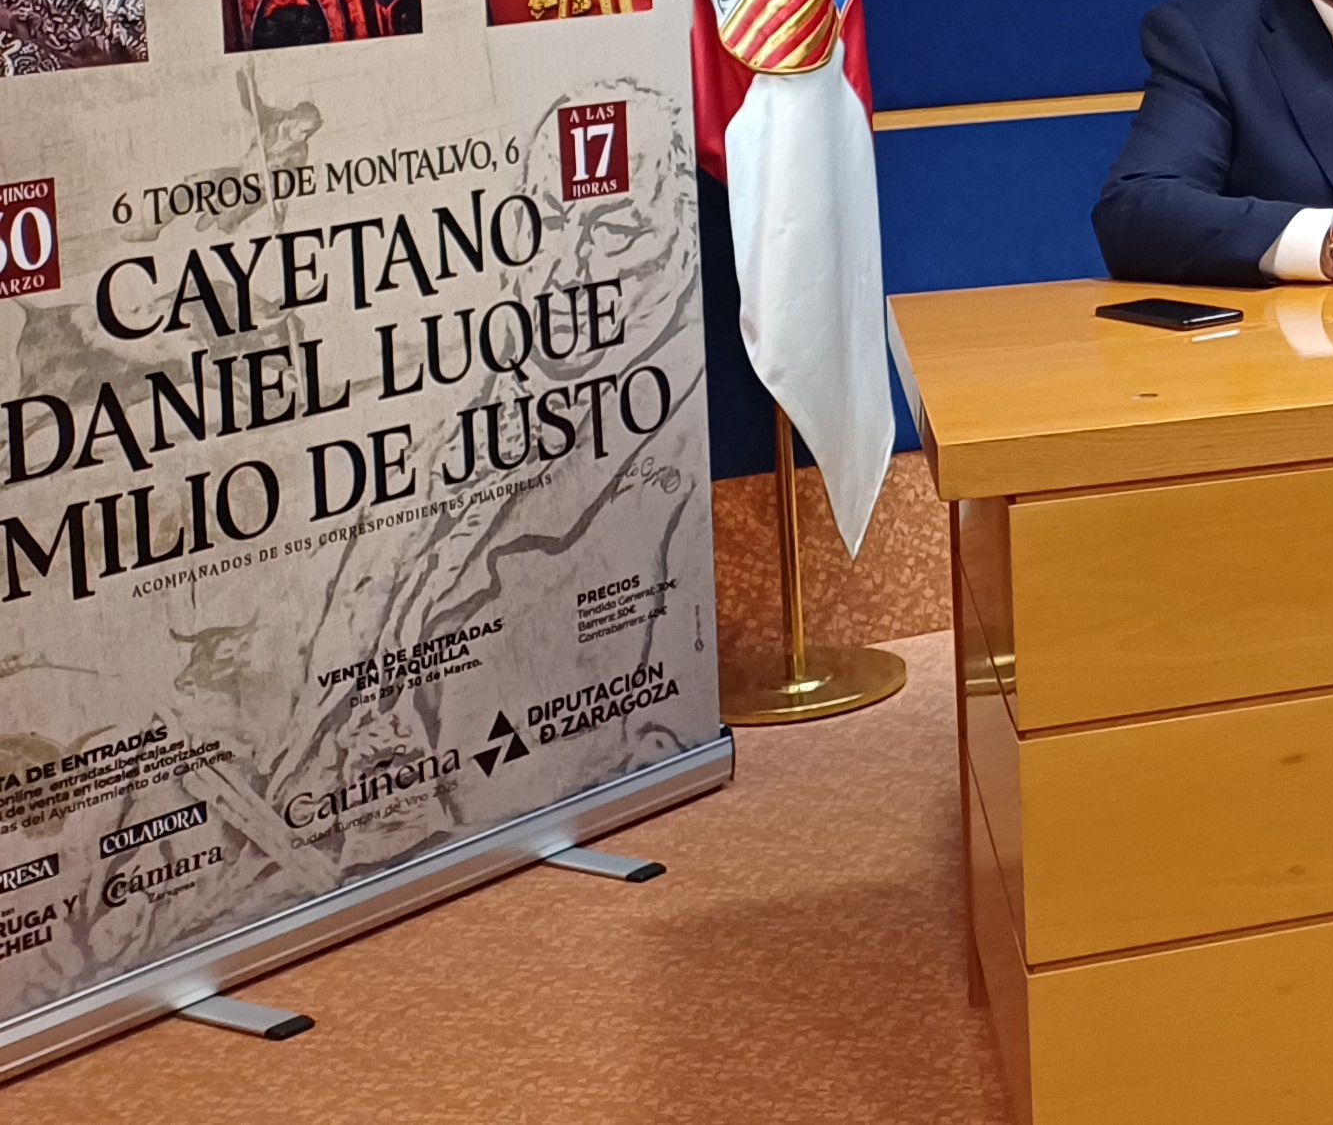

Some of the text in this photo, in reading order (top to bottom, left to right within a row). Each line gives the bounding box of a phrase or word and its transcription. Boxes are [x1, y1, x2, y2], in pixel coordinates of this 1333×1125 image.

[569, 104, 616, 124] A LAS
[111, 135, 521, 226] 6 TOROS DE MONTALVO, 6
[570, 122, 615, 182] 17
[0, 182, 49, 207] MINGO
[572, 178, 618, 198] HORAS
[0, 206, 52, 271] 0
[95, 189, 544, 342] CAYETANO
[1, 278, 627, 485] DANIEL LUQUE
[305, 424, 418, 523] DE
[440, 365, 672, 486] JUSTO
[131, 473, 553, 599] ACOMPAÑADOS DE SUS CORRESPONDIENTES CUADRILLAS
[576, 574, 641, 608] PRECIOS
[577, 599, 617, 620] Tendido
[317, 618, 505, 688] VENTA DE ENTRADAS
[356, 644, 470, 691] EN TAQUILLA
[407, 676, 423, 690] 30
[425, 670, 441, 683] de
[527, 661, 664, 728] DIPUTACIÓN
[560, 679, 680, 738] ZARAGOZA
[5, 804, 26, 819] de
[28, 790, 70, 812] venta
[73, 783, 91, 798] en
[94, 767, 141, 791] locales
[142, 740, 221, 775] autorizados
[26, 761, 58, 785] DE
[61, 725, 169, 773] ENTRADAS
[21, 809, 45, 829] del
[48, 778, 149, 821] Ayuntamiento
[152, 766, 170, 785] de
[284, 744, 462, 829] Cariñena
[102, 806, 205, 855] COLABORA
[0, 858, 54, 890] RESA
[63, 894, 79, 915] Y
